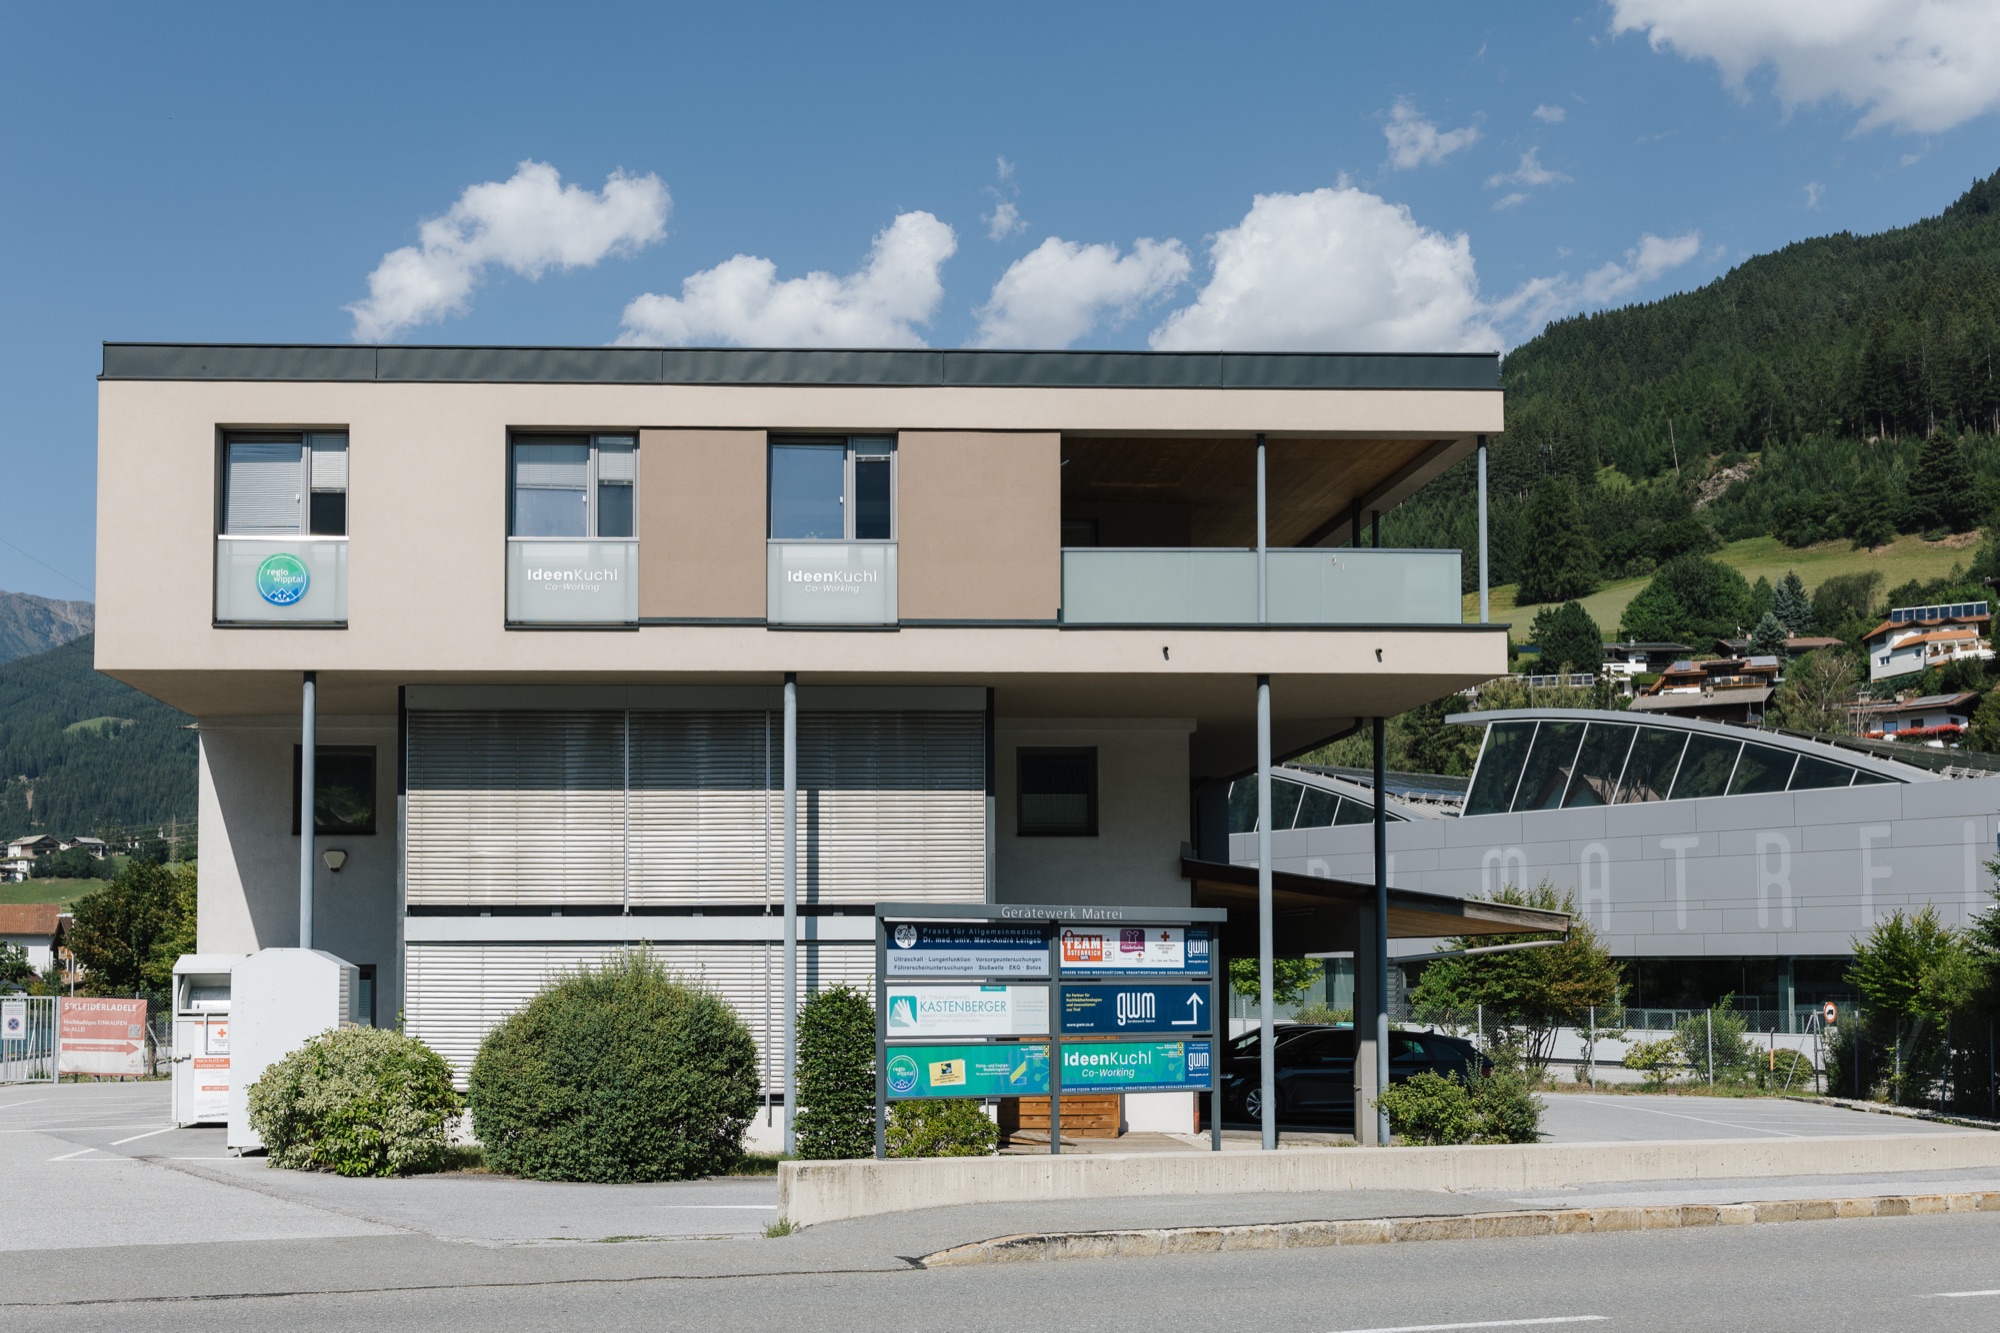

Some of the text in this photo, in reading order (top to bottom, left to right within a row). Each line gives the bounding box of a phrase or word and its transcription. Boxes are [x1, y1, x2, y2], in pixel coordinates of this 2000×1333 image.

[267, 568, 288, 577] regio
[527, 568, 618, 581] IdeenKuchl
[787, 570, 877, 582] IdeenKuchl
[273, 575, 304, 585] wipptal
[545, 583, 600, 593] Co-Working
[805, 584, 860, 594] Co-Working
[1481, 820, 1977, 932] MATREI
[1001, 907, 1123, 920] Gerätewerk Matrei
[969, 928, 1041, 936] Allgemeinmedizin
[1016, 937, 1041, 945] Leitgeb
[1064, 937, 1101, 949] TEAM
[1187, 939, 1208, 957] gwm
[920, 1001, 1007, 1012] KASTENBERGER
[1117, 992, 1155, 1026] gwm
[1064, 1050, 1151, 1067] IdeenKuchl
[1188, 1053, 1209, 1071] gwm
[1081, 1068, 1135, 1078] Co-Working
